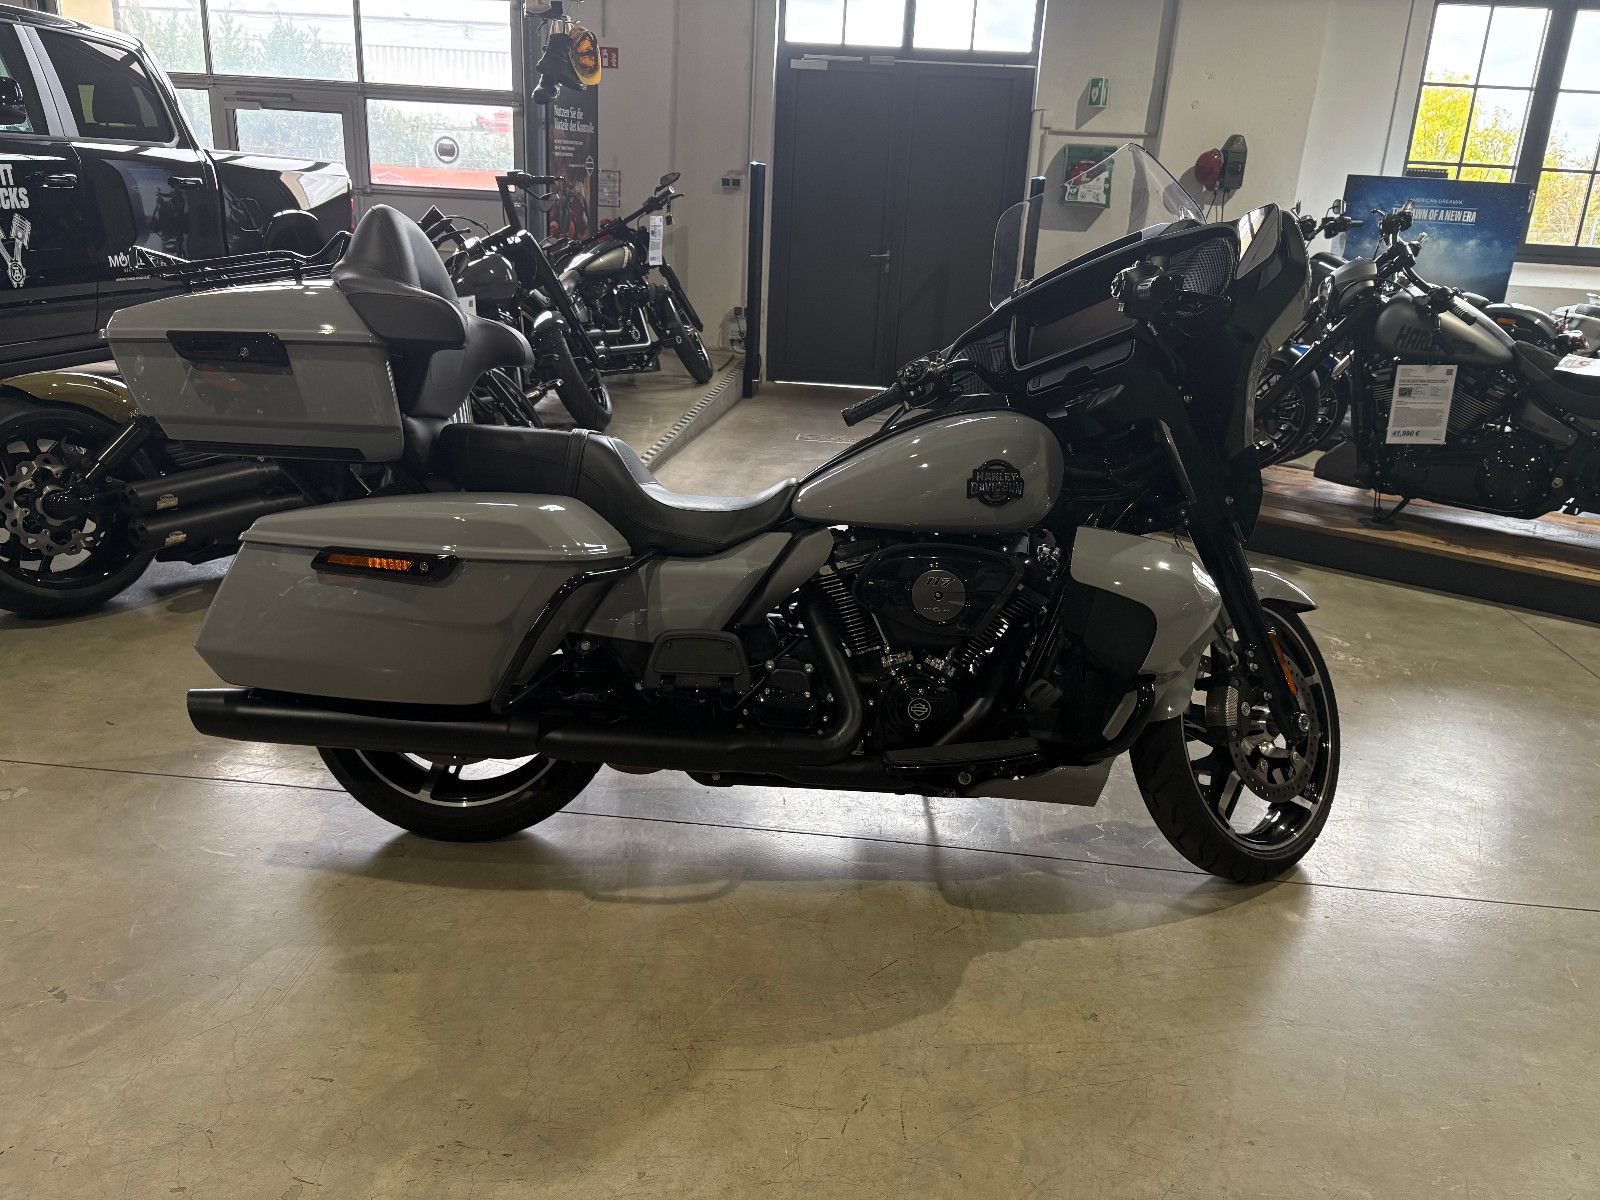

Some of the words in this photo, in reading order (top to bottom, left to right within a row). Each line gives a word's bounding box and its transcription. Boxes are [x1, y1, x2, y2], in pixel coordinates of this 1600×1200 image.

[0, 187, 30, 210] CKS
[1428, 209, 1439, 220] OF
[1438, 210, 1444, 220] A
[1444, 210, 1463, 222] NEW
[1462, 211, 1477, 222] ERA
[976, 471, 1018, 481] HARLEY
